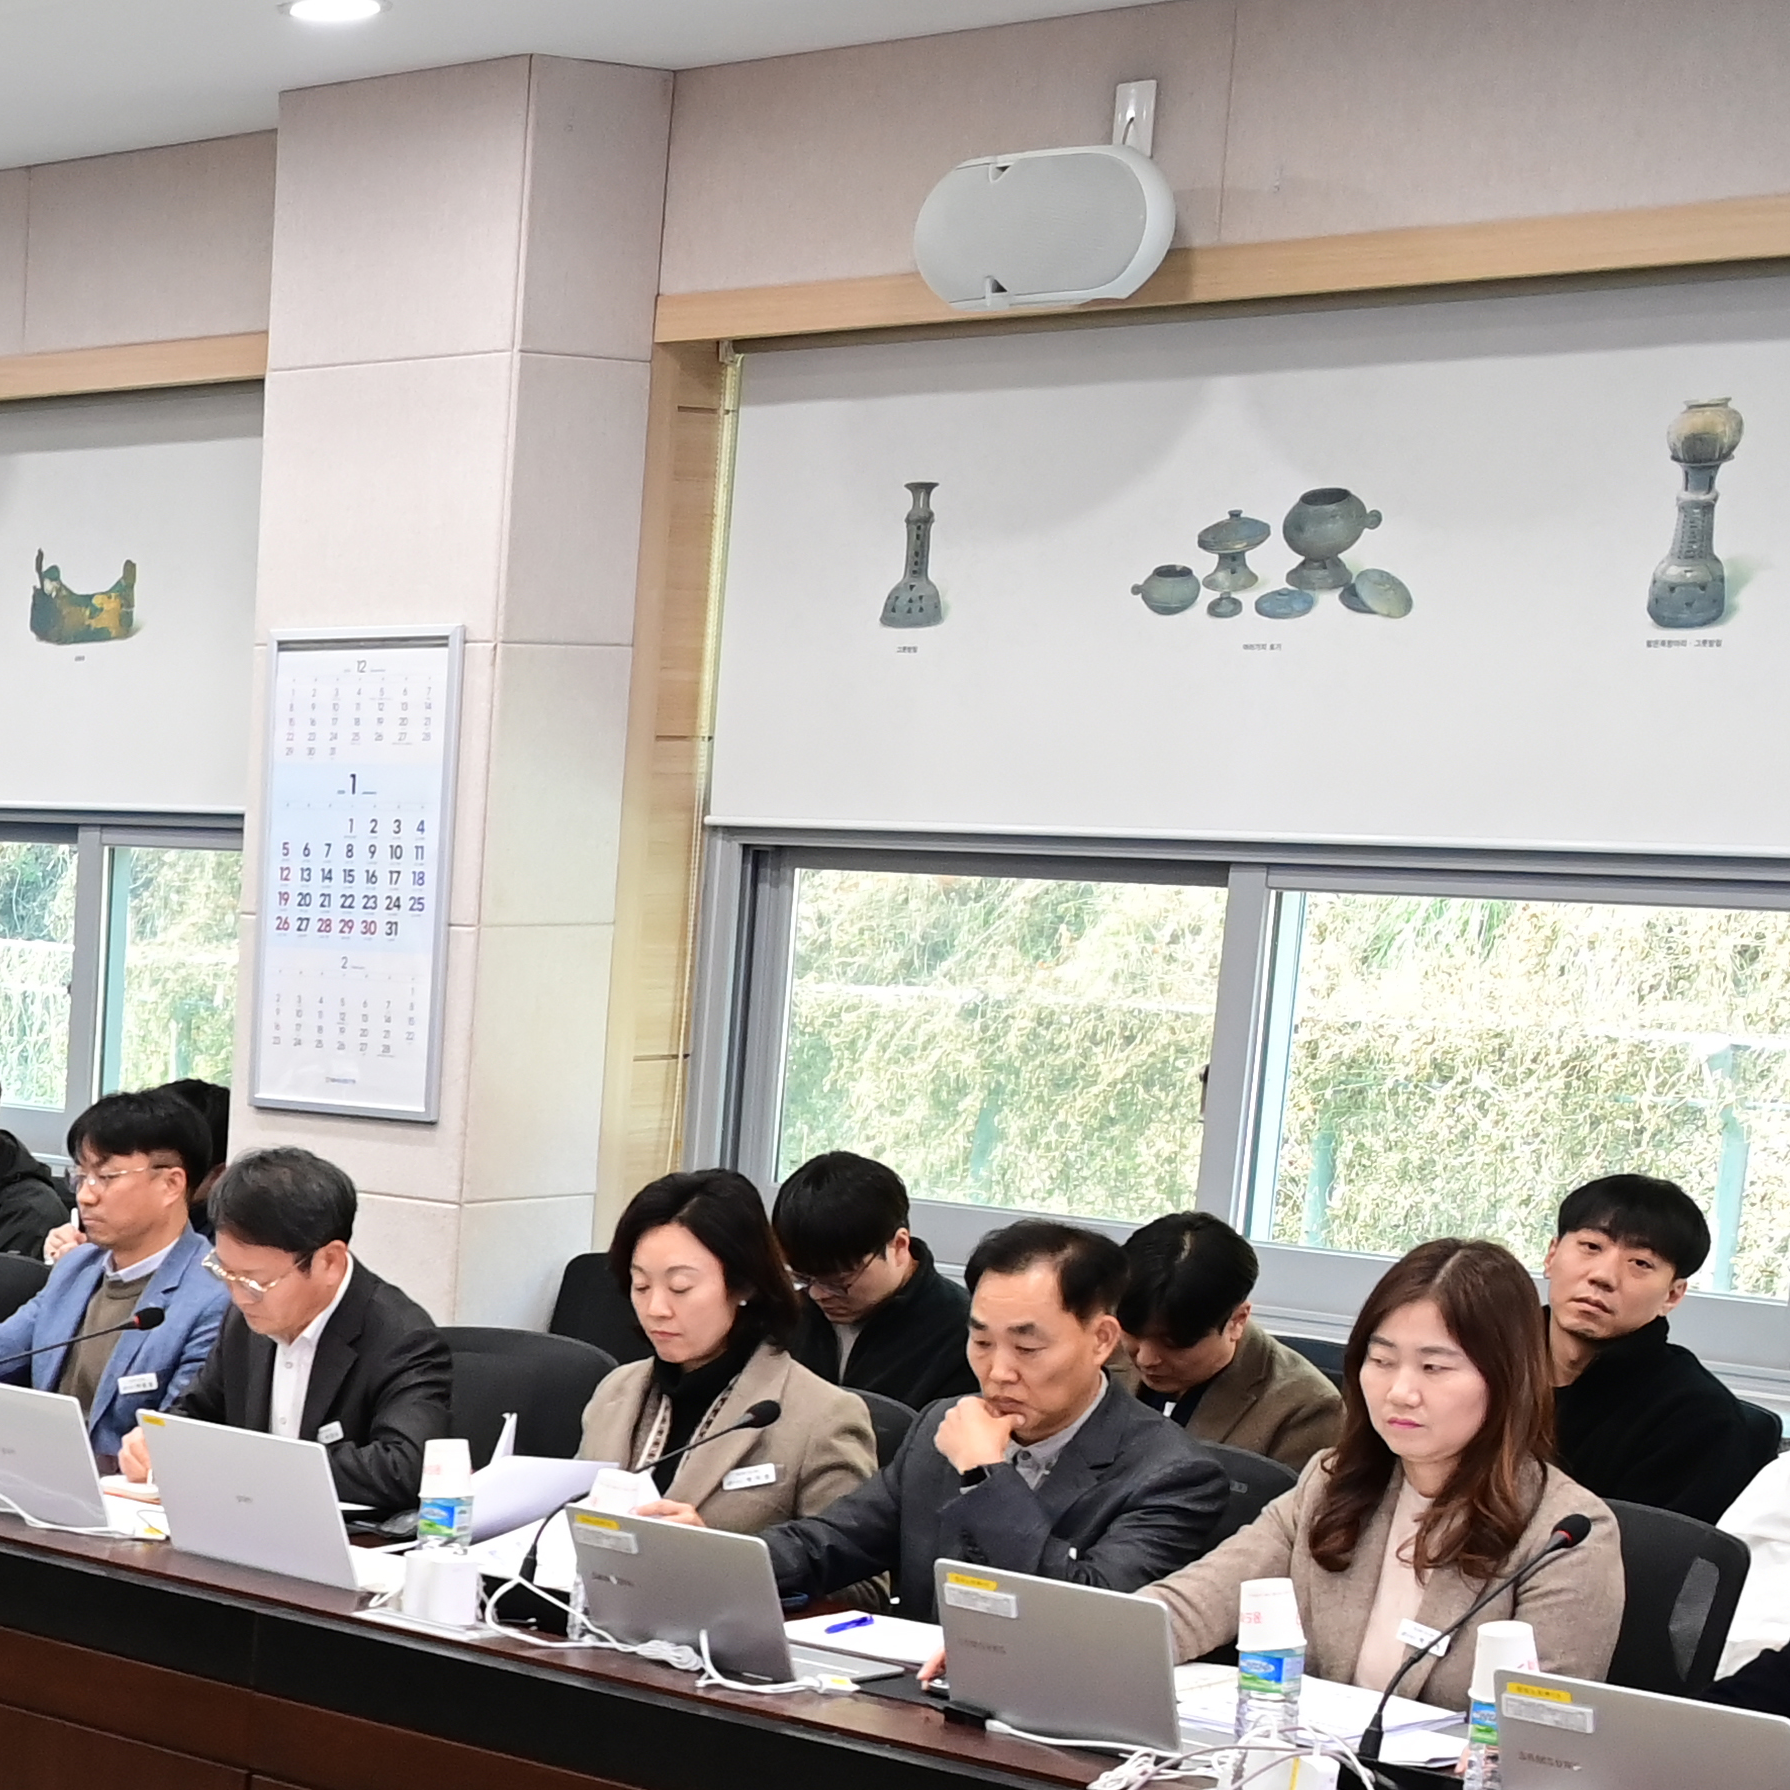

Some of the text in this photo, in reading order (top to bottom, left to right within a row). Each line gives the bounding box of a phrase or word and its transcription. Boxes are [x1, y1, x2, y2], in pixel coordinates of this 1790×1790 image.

[357, 660, 367, 673] 12
[350, 773, 356, 795] 1
[349, 818, 425, 834] 1 2 3 4
[282, 842, 424, 860] 5 6 7 8 9 10 11
[280, 866, 425, 886] 12 13 14 15 16 17 18
[278, 891, 425, 912] 19 20 21 22 23 24 25
[275, 916, 398, 936] 26 27 28 29 30 31
[341, 956, 348, 969] 2
